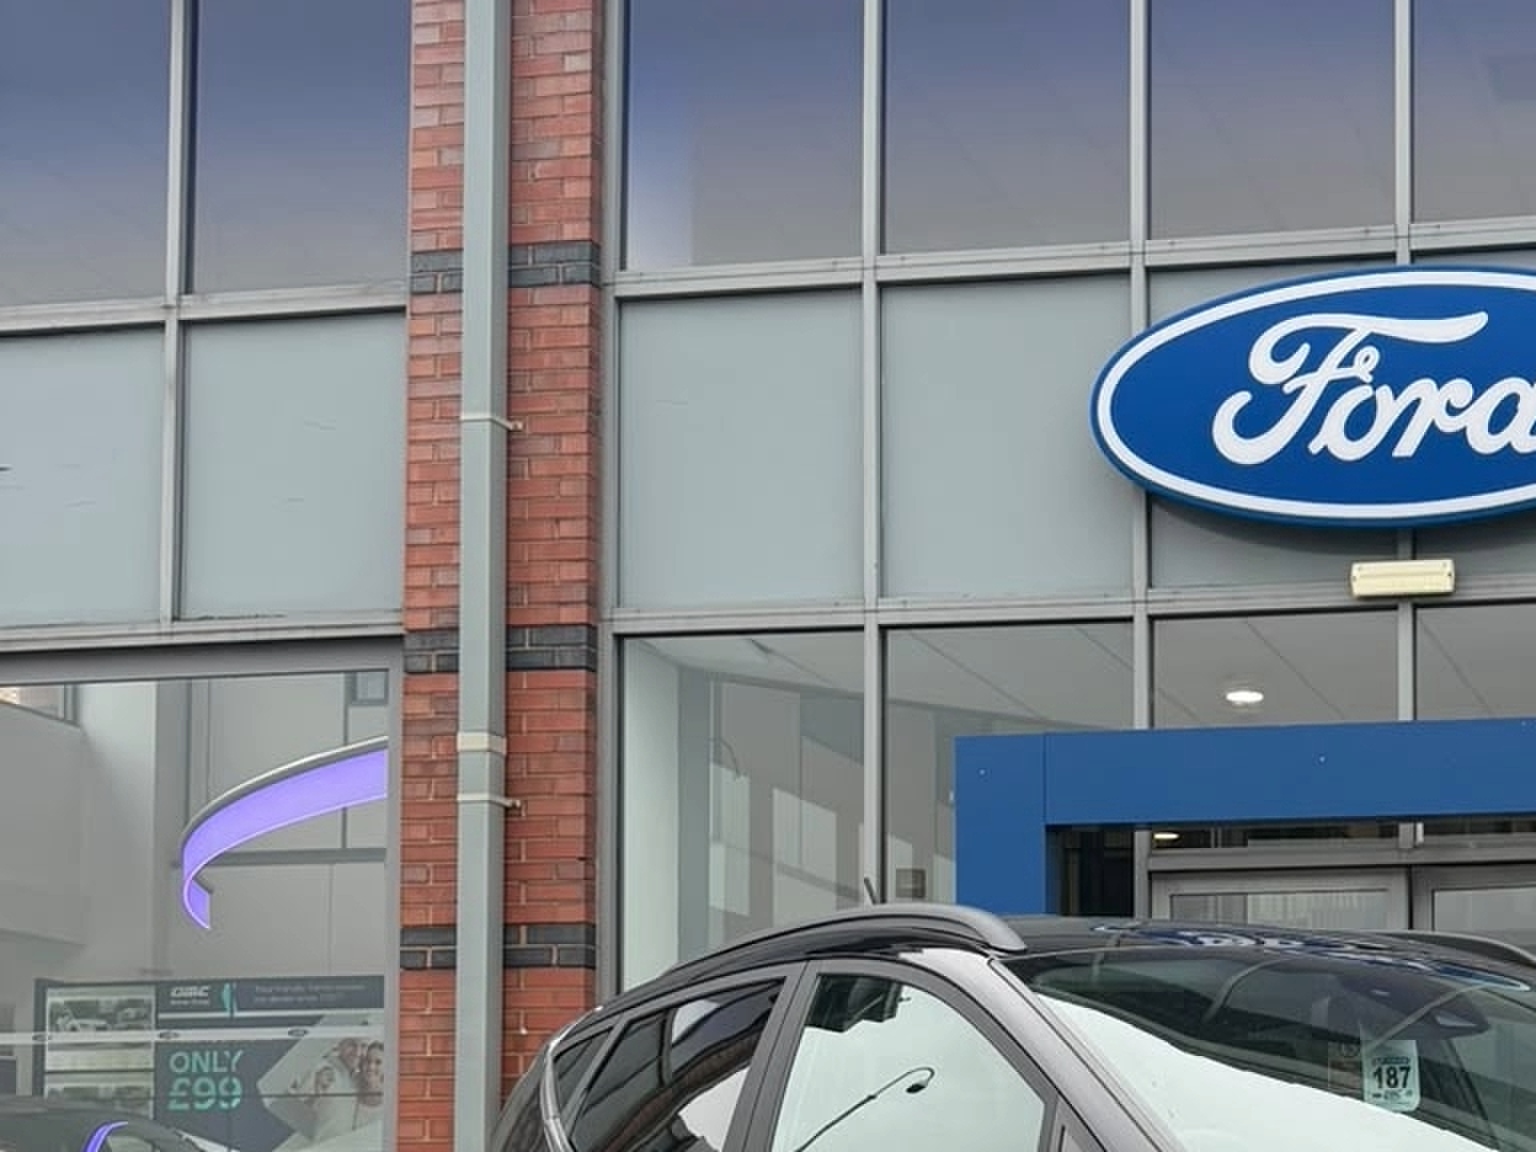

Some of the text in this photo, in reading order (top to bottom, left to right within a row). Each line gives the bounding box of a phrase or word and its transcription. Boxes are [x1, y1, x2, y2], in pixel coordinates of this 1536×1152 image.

[169, 1049, 245, 1073] ONLY
[1373, 1066, 1411, 1089] 187
[167, 1077, 243, 1111] £99
